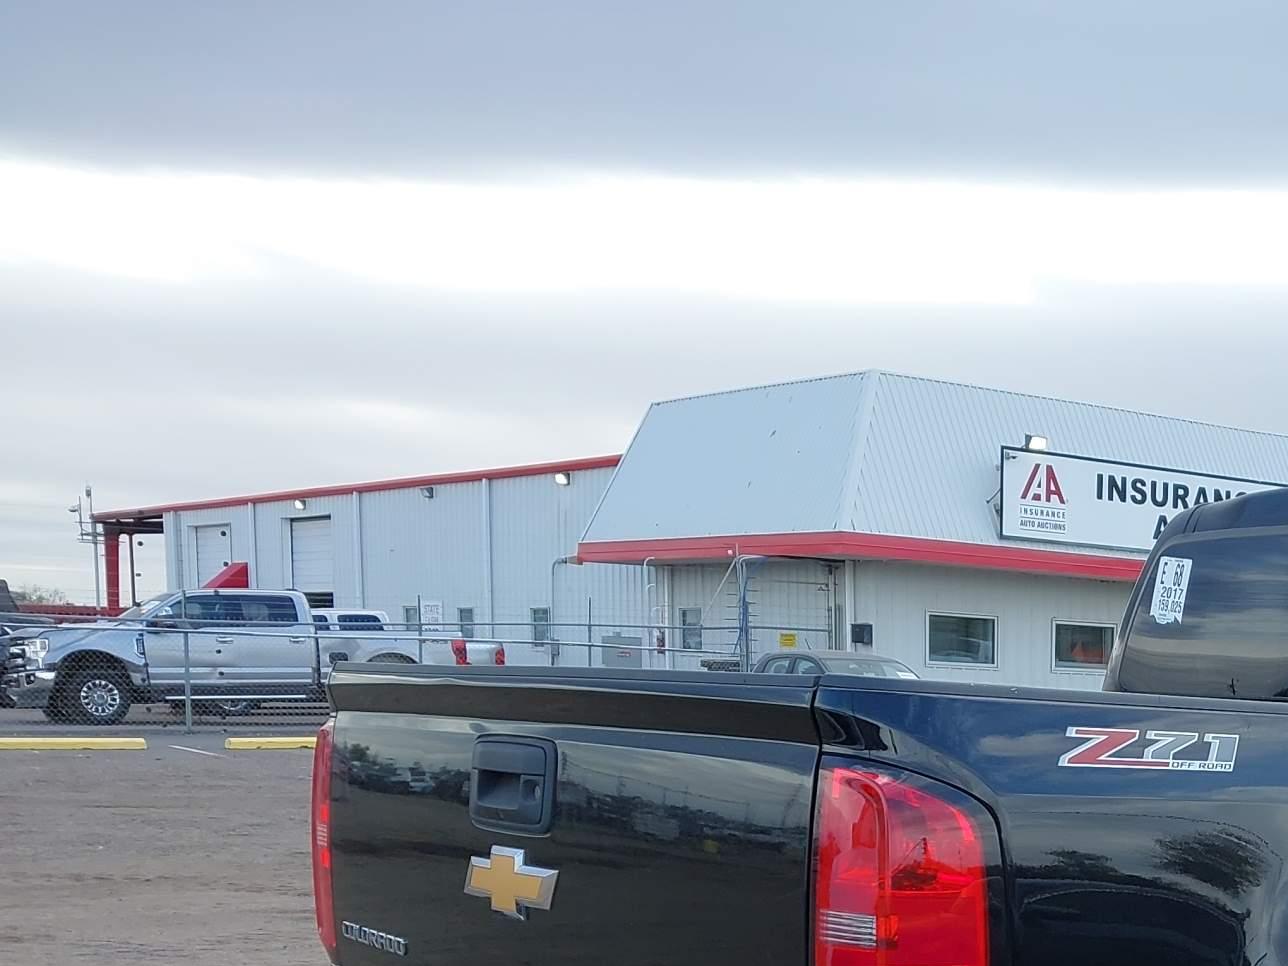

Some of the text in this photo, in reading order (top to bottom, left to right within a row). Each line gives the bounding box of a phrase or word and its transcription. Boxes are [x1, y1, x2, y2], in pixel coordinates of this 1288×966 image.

[1096, 473, 1247, 509] INSURAN
[1020, 507, 1066, 519] INSURANCE
[1020, 519, 1066, 532] AUTO AUCTIONS
[1160, 586, 1184, 600] 2017
[1058, 726, 1240, 771] Z71
[1171, 761, 1232, 770] OFF ROAD
[342, 921, 407, 956] COLORADO
